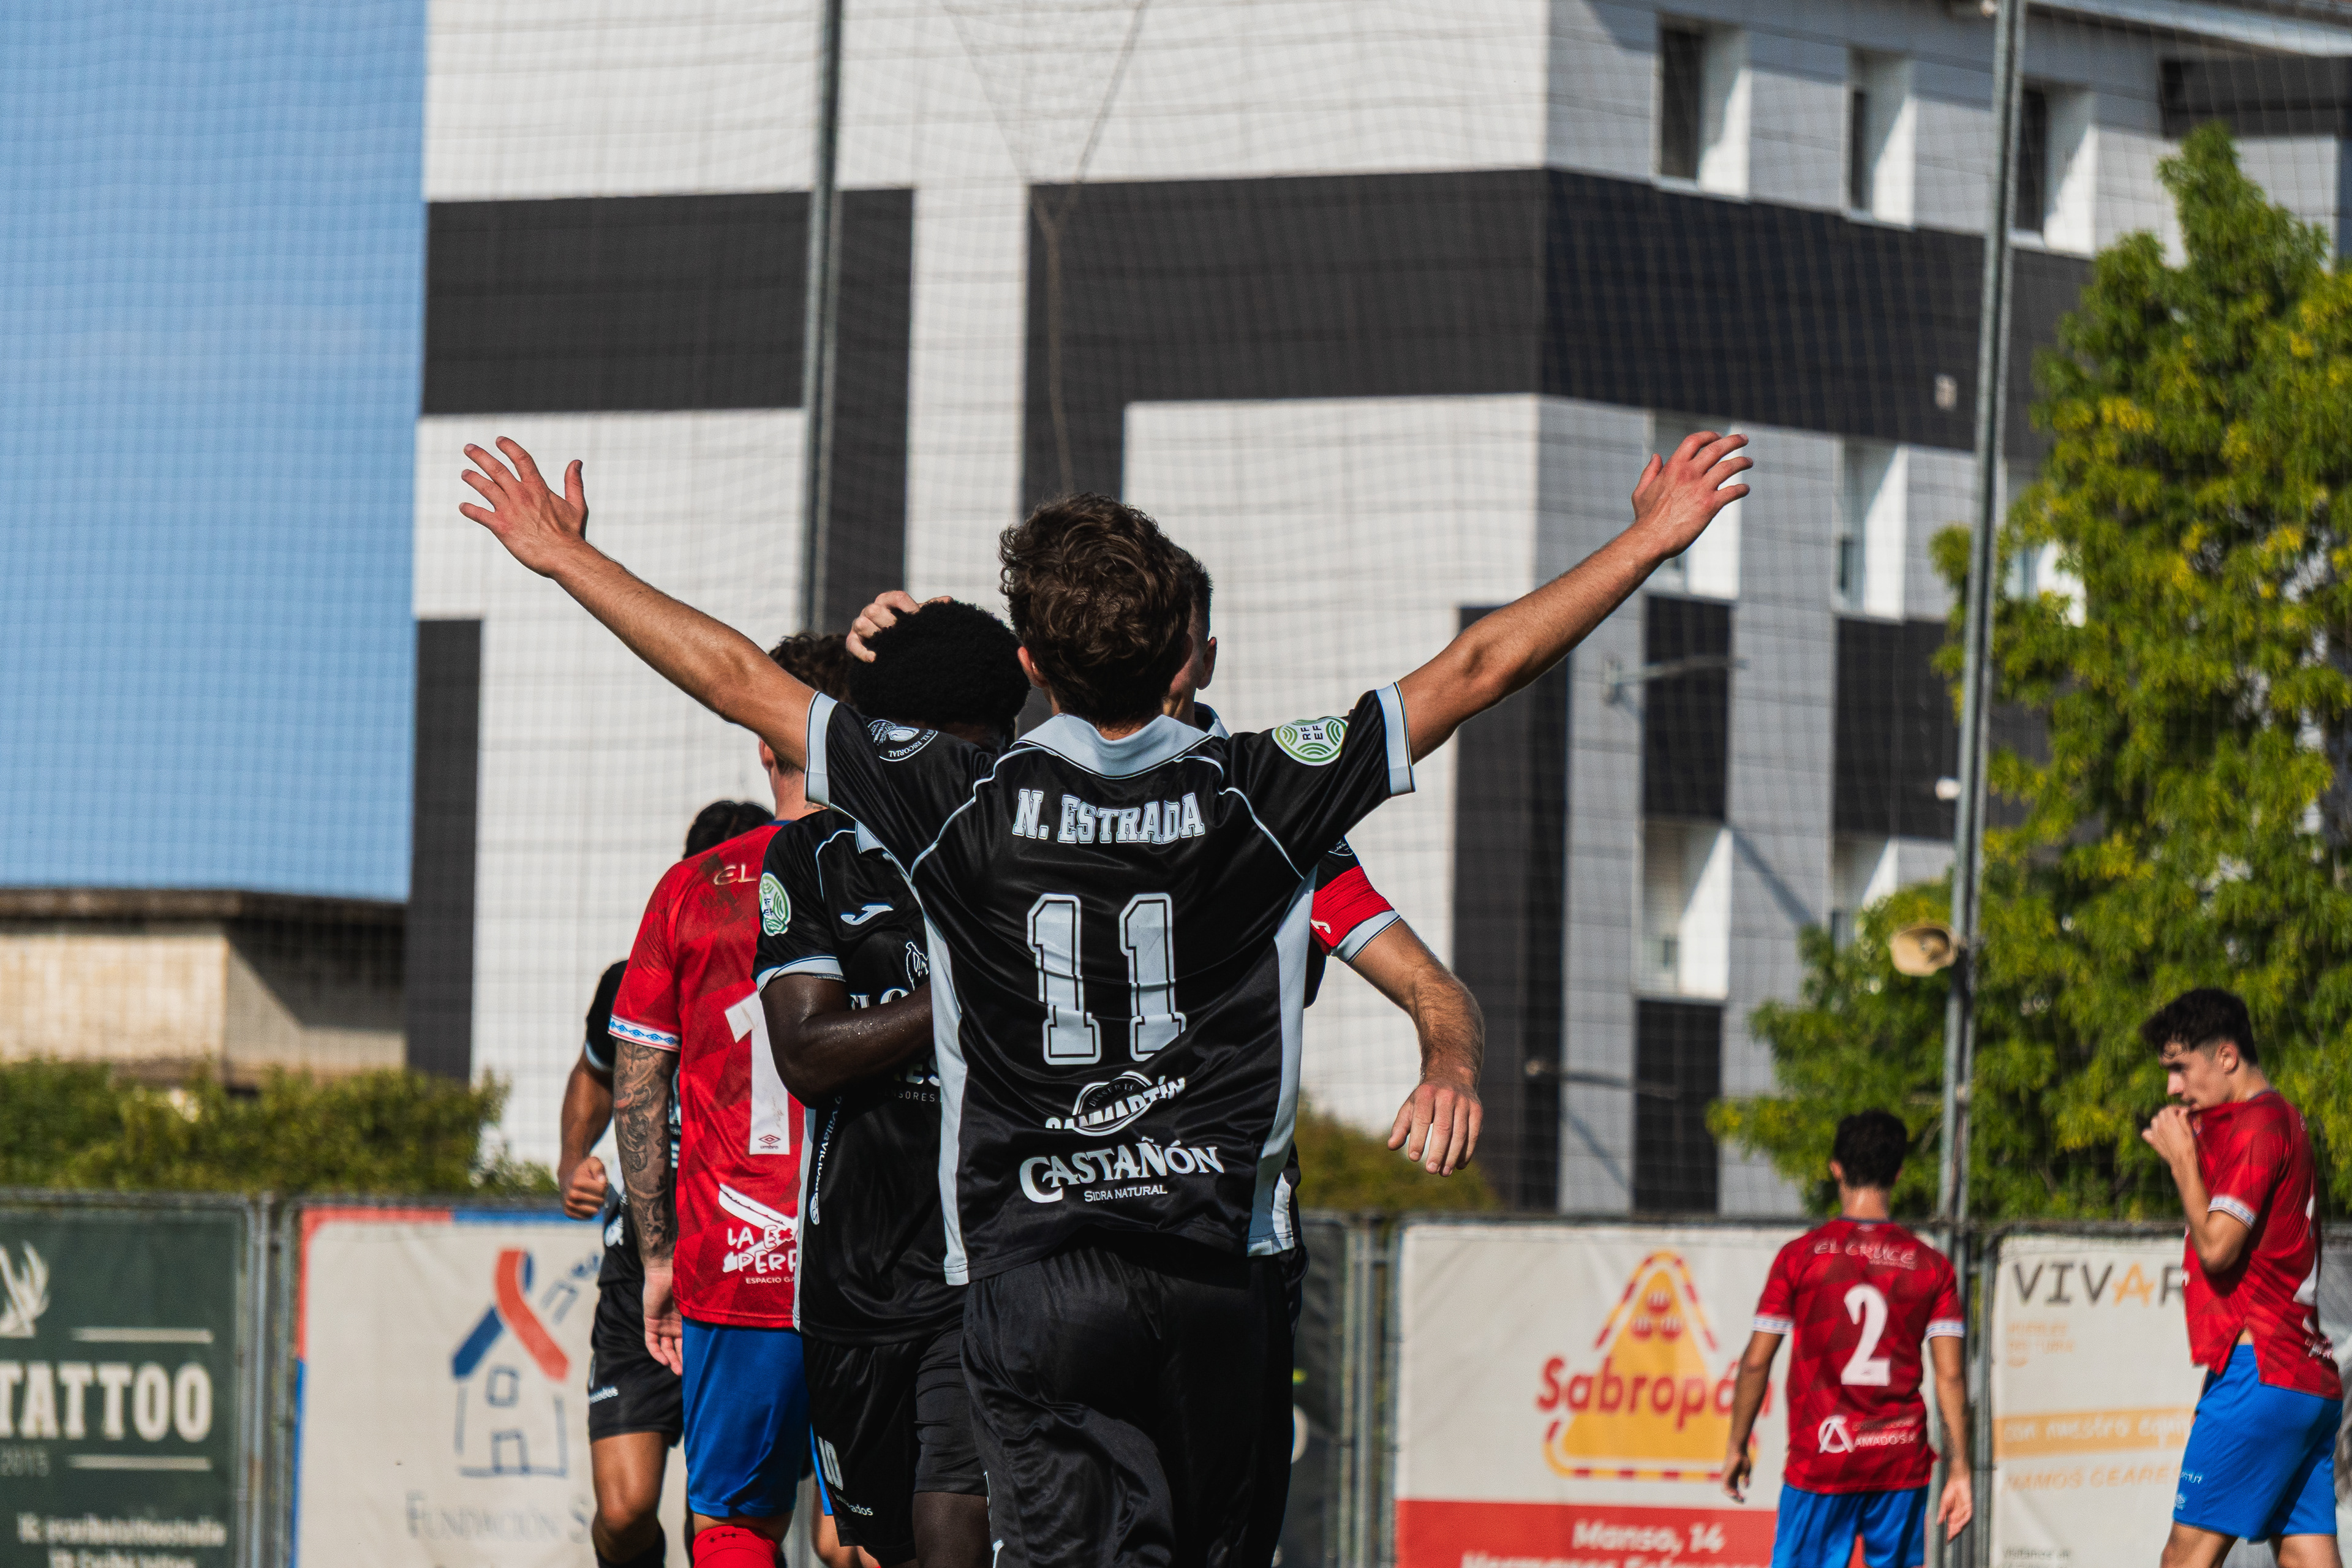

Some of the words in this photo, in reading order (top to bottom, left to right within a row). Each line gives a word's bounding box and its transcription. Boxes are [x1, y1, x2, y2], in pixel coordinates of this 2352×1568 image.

[1012, 789, 1049, 839] N.
[1058, 793, 1205, 845] ESTRADA
[714, 864, 758, 886] EL
[1027, 892, 1186, 1066] 11
[1089, 1084, 1134, 1107] DESSERTS
[1020, 1136, 1224, 1204] CASTAÑÓN
[1115, 1185, 1168, 1199] NATURAL
[728, 1226, 755, 1250] LA
[1814, 1237, 1842, 1254] EL
[1845, 1241, 1918, 1264] CRUCE
[1841, 1284, 1891, 1386] 2
[0, 1360, 213, 1442] TATTOO
[1574, 1519, 1683, 1557] Manso,
[1689, 1522, 1727, 1553] 14
